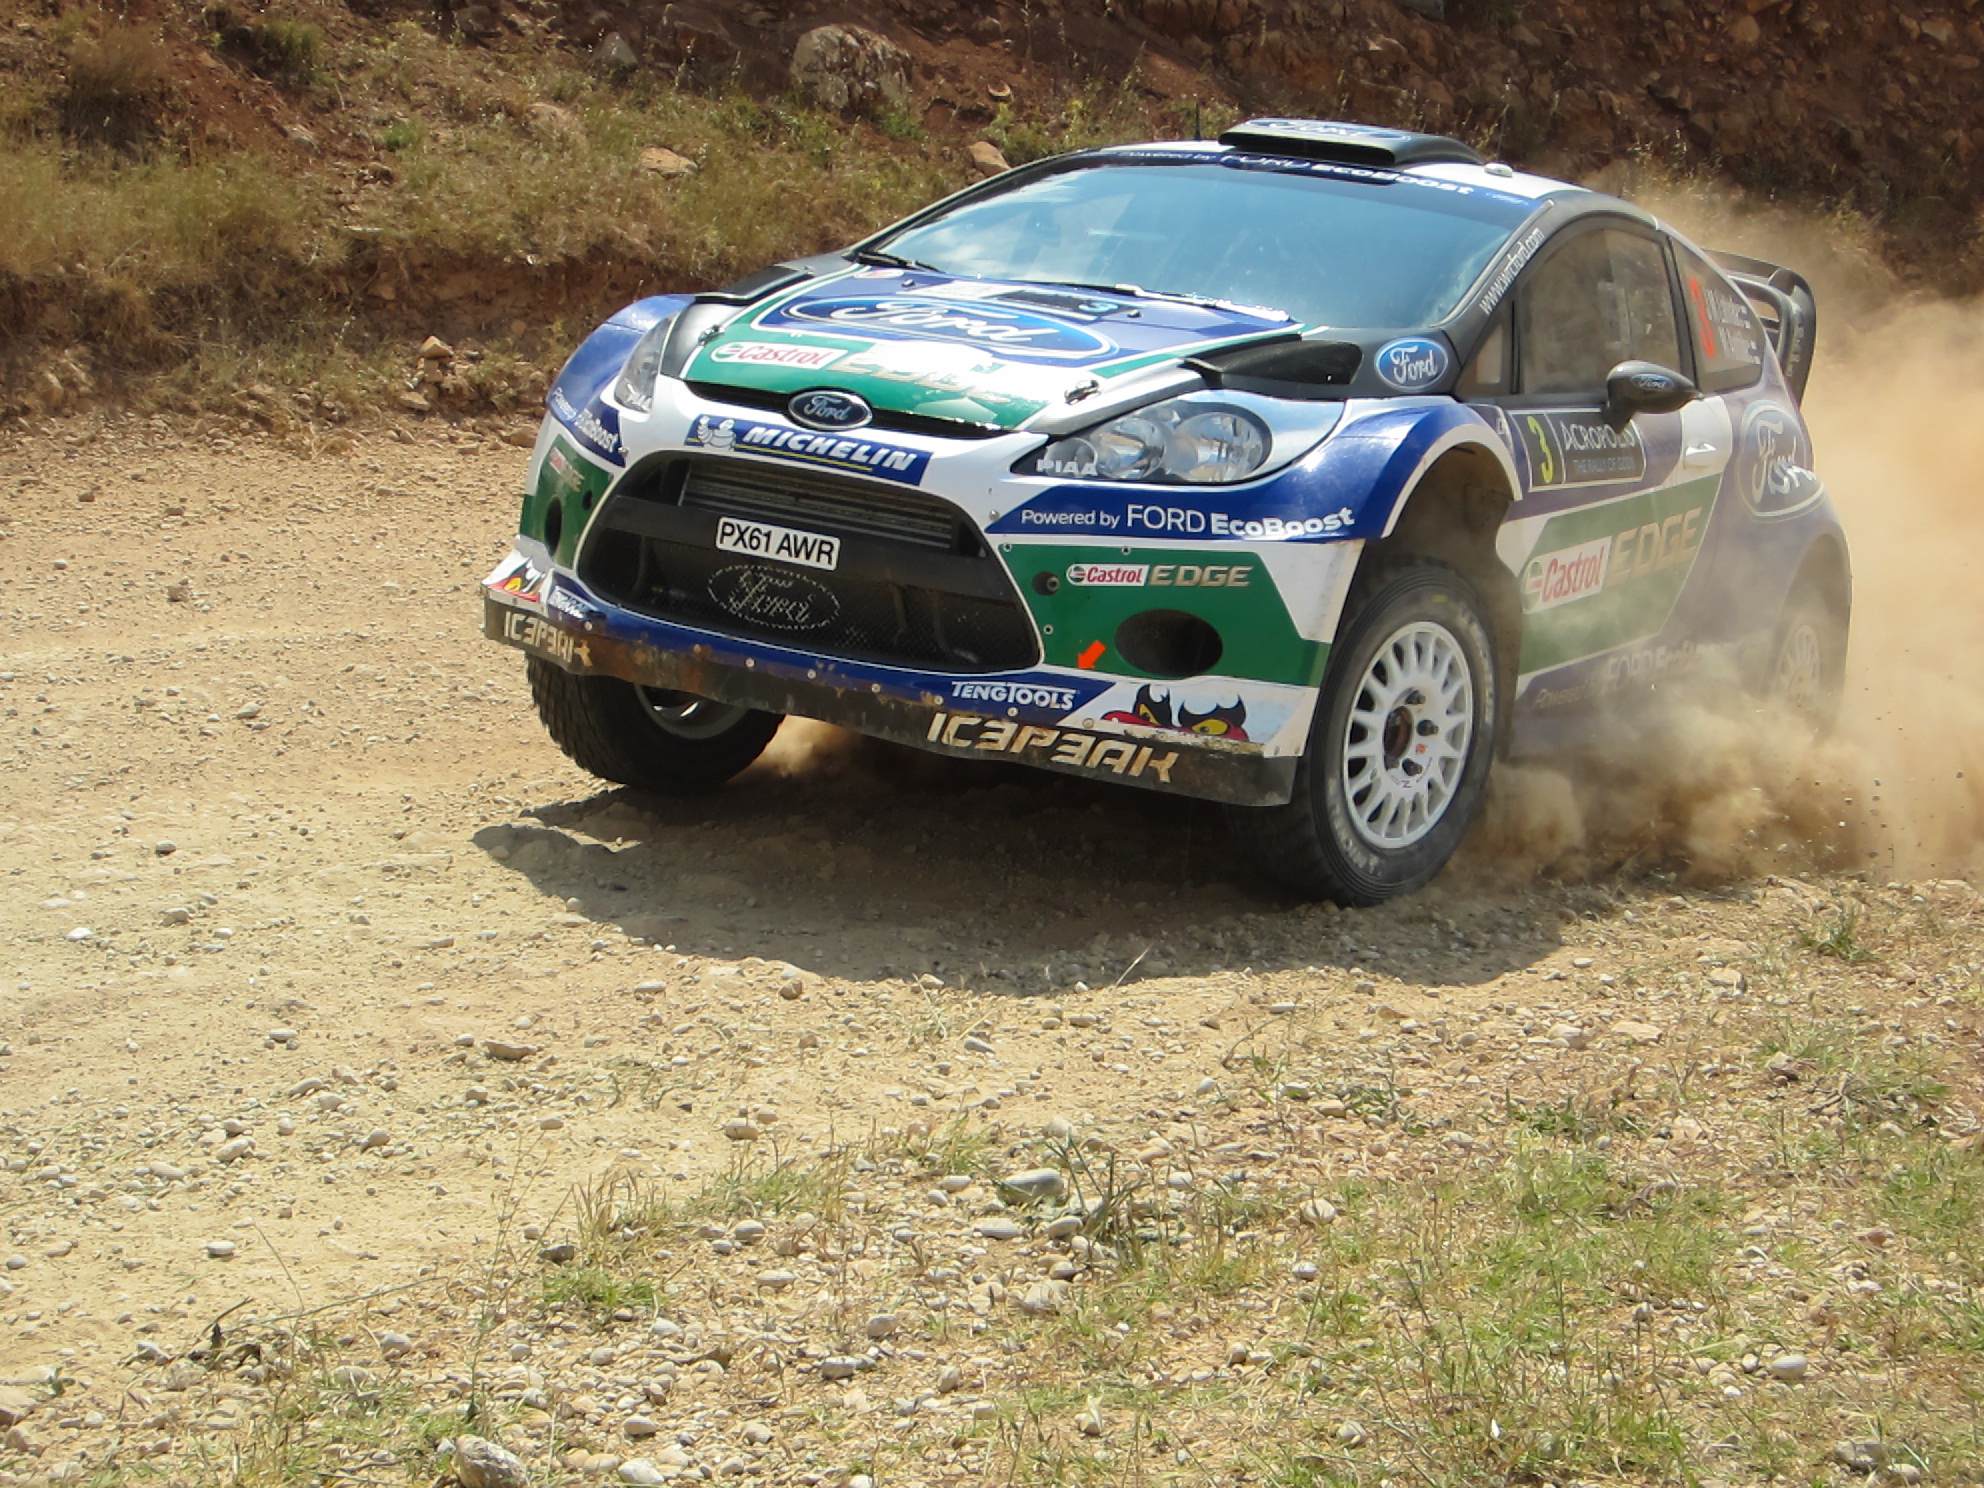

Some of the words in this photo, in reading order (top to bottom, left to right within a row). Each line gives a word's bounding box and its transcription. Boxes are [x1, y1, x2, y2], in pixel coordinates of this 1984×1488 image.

[831, 301, 1060, 343] Ford
[738, 345, 835, 366] Castrol
[1390, 345, 1438, 384] Ford
[804, 395, 852, 421] Ford
[742, 425, 918, 471] MICHELIN
[1527, 416, 1554, 484] 3
[1036, 459, 1098, 477] PIAA
[1021, 509, 1096, 527] Powered
[1099, 509, 1120, 529] by
[1127, 504, 1206, 533] FORD
[1211, 507, 1355, 541] EcoBoost
[720, 522, 772, 552] PX61
[776, 533, 835, 565] AWR
[1542, 545, 1605, 602] Castrol
[1607, 506, 1703, 588] EDGE
[1086, 566, 1143, 584] Castrol
[1150, 565, 1254, 587] EDGE
